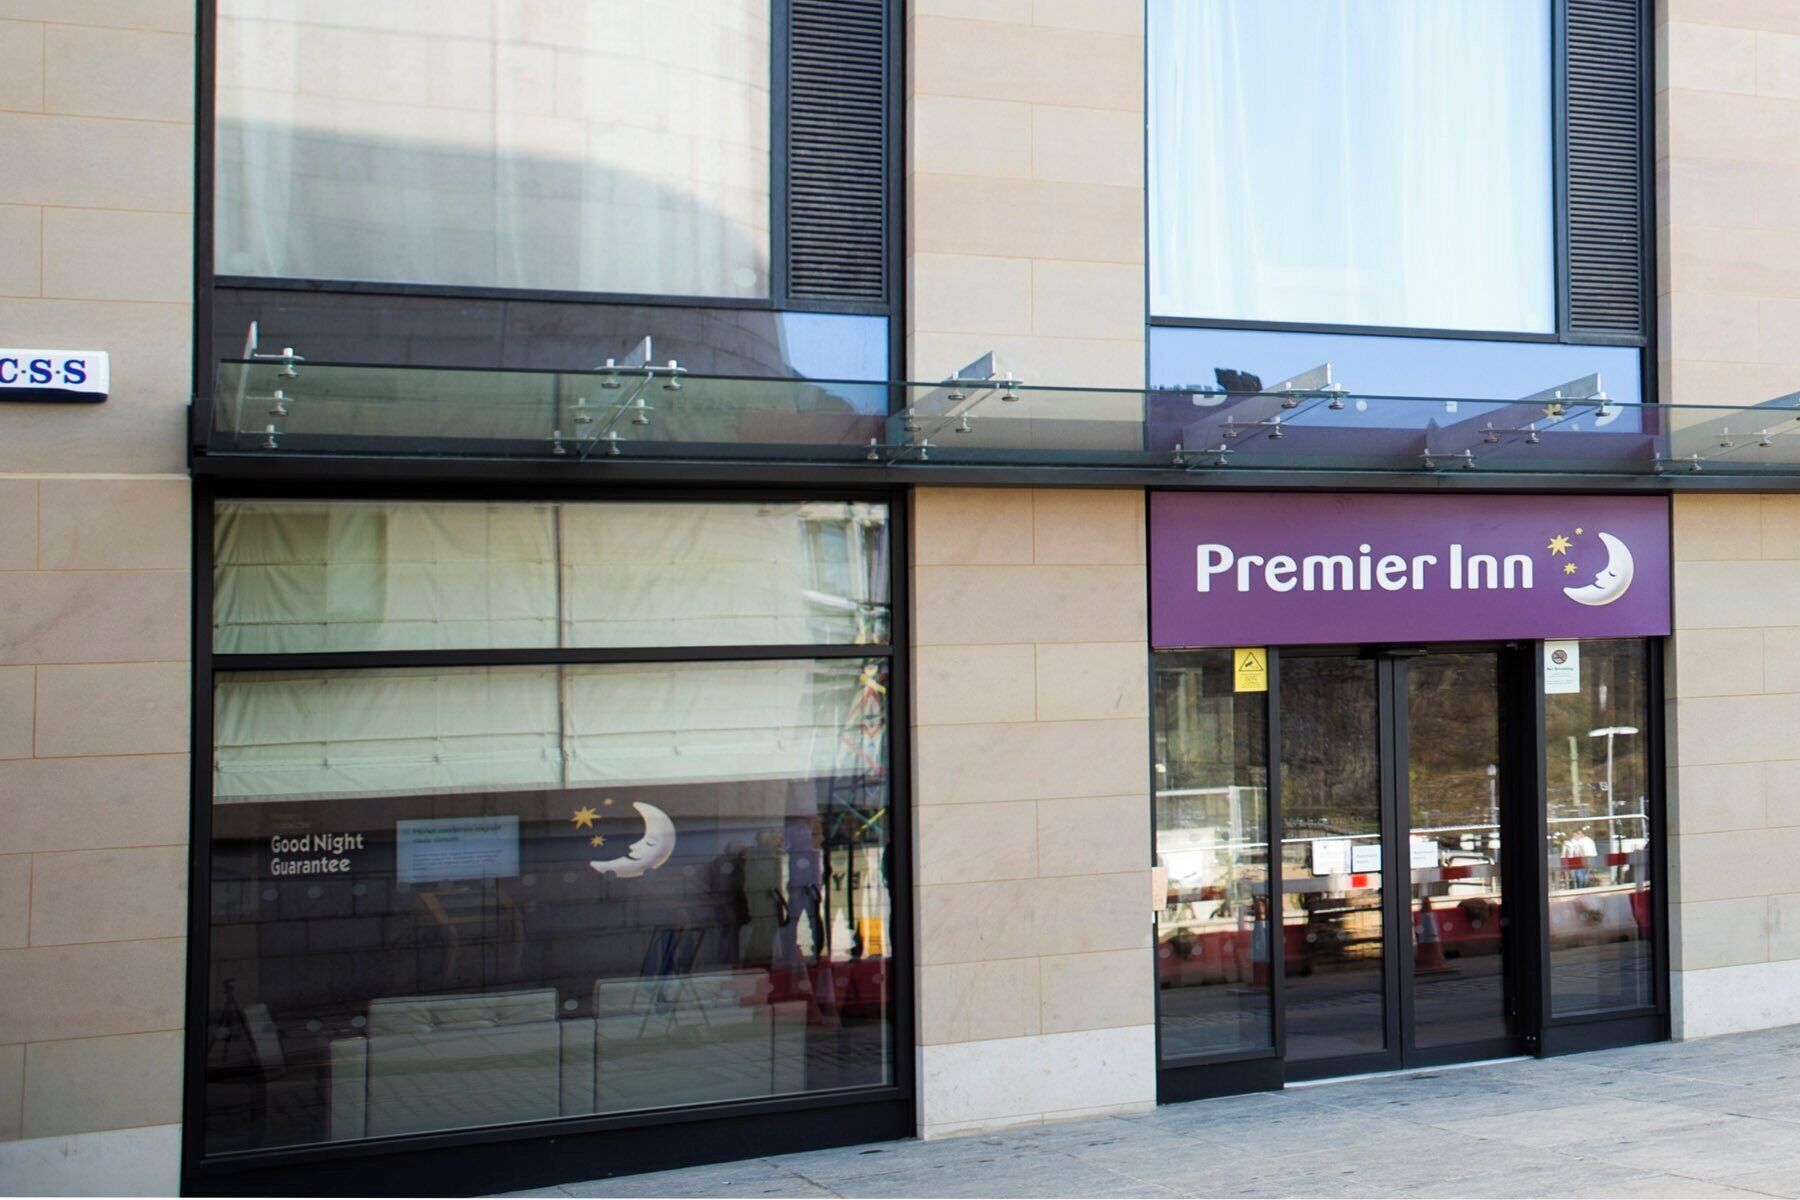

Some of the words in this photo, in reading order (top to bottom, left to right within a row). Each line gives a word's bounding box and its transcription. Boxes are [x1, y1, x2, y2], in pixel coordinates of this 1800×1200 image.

[1197, 544, 1437, 592] Premier
[1451, 544, 1533, 589] Inn
[272, 835, 309, 852] Good
[315, 834, 362, 854] Night
[272, 857, 350, 875] Guarantee
